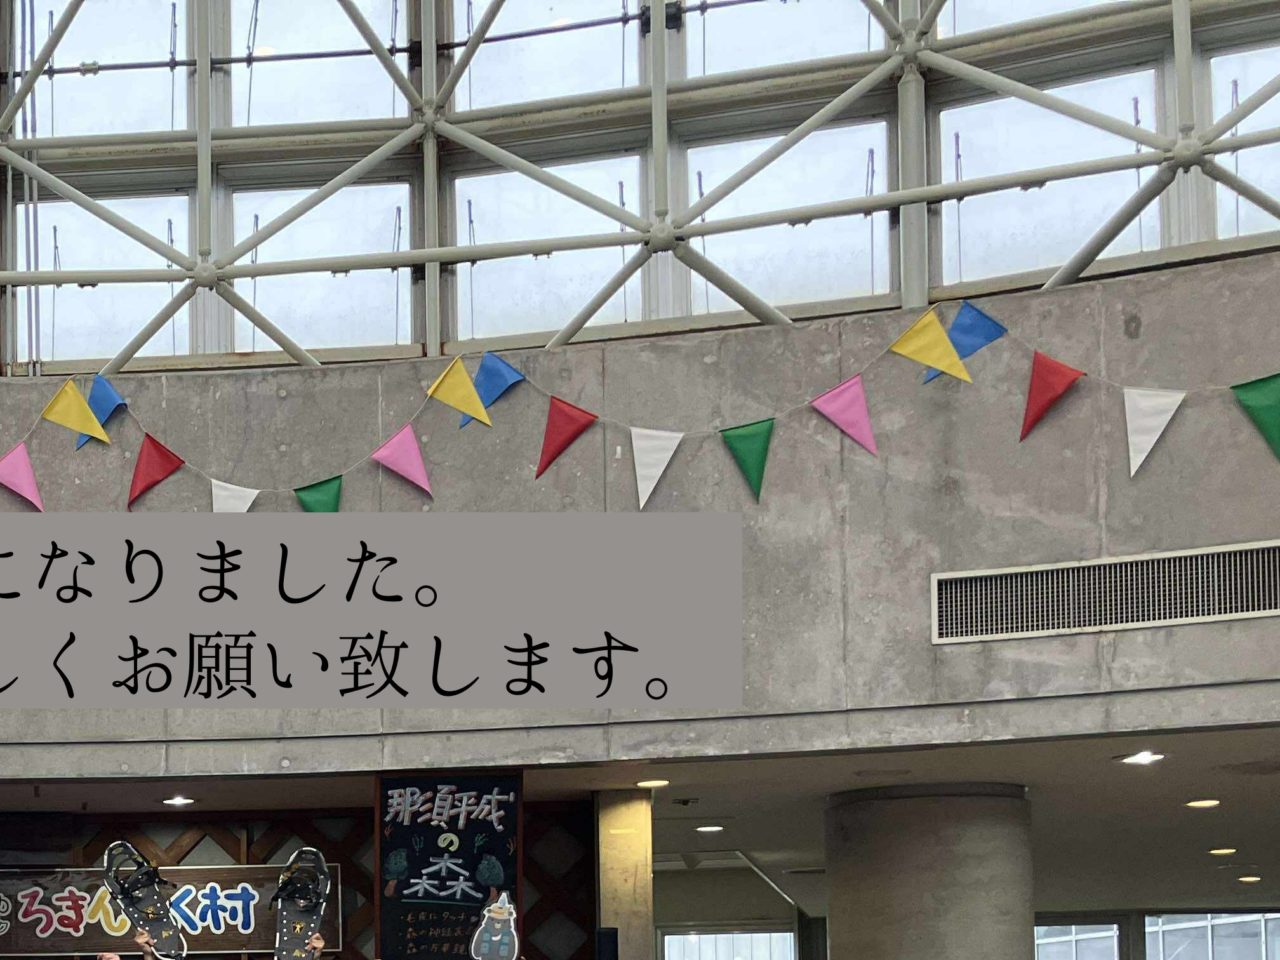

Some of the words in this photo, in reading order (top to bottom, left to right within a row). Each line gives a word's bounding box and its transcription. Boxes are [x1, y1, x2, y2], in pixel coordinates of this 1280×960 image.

[384, 785, 516, 831] 那須平成
[437, 832, 460, 852] の
[403, 853, 484, 899] 森
[17, 882, 259, 937] ろまんく村
